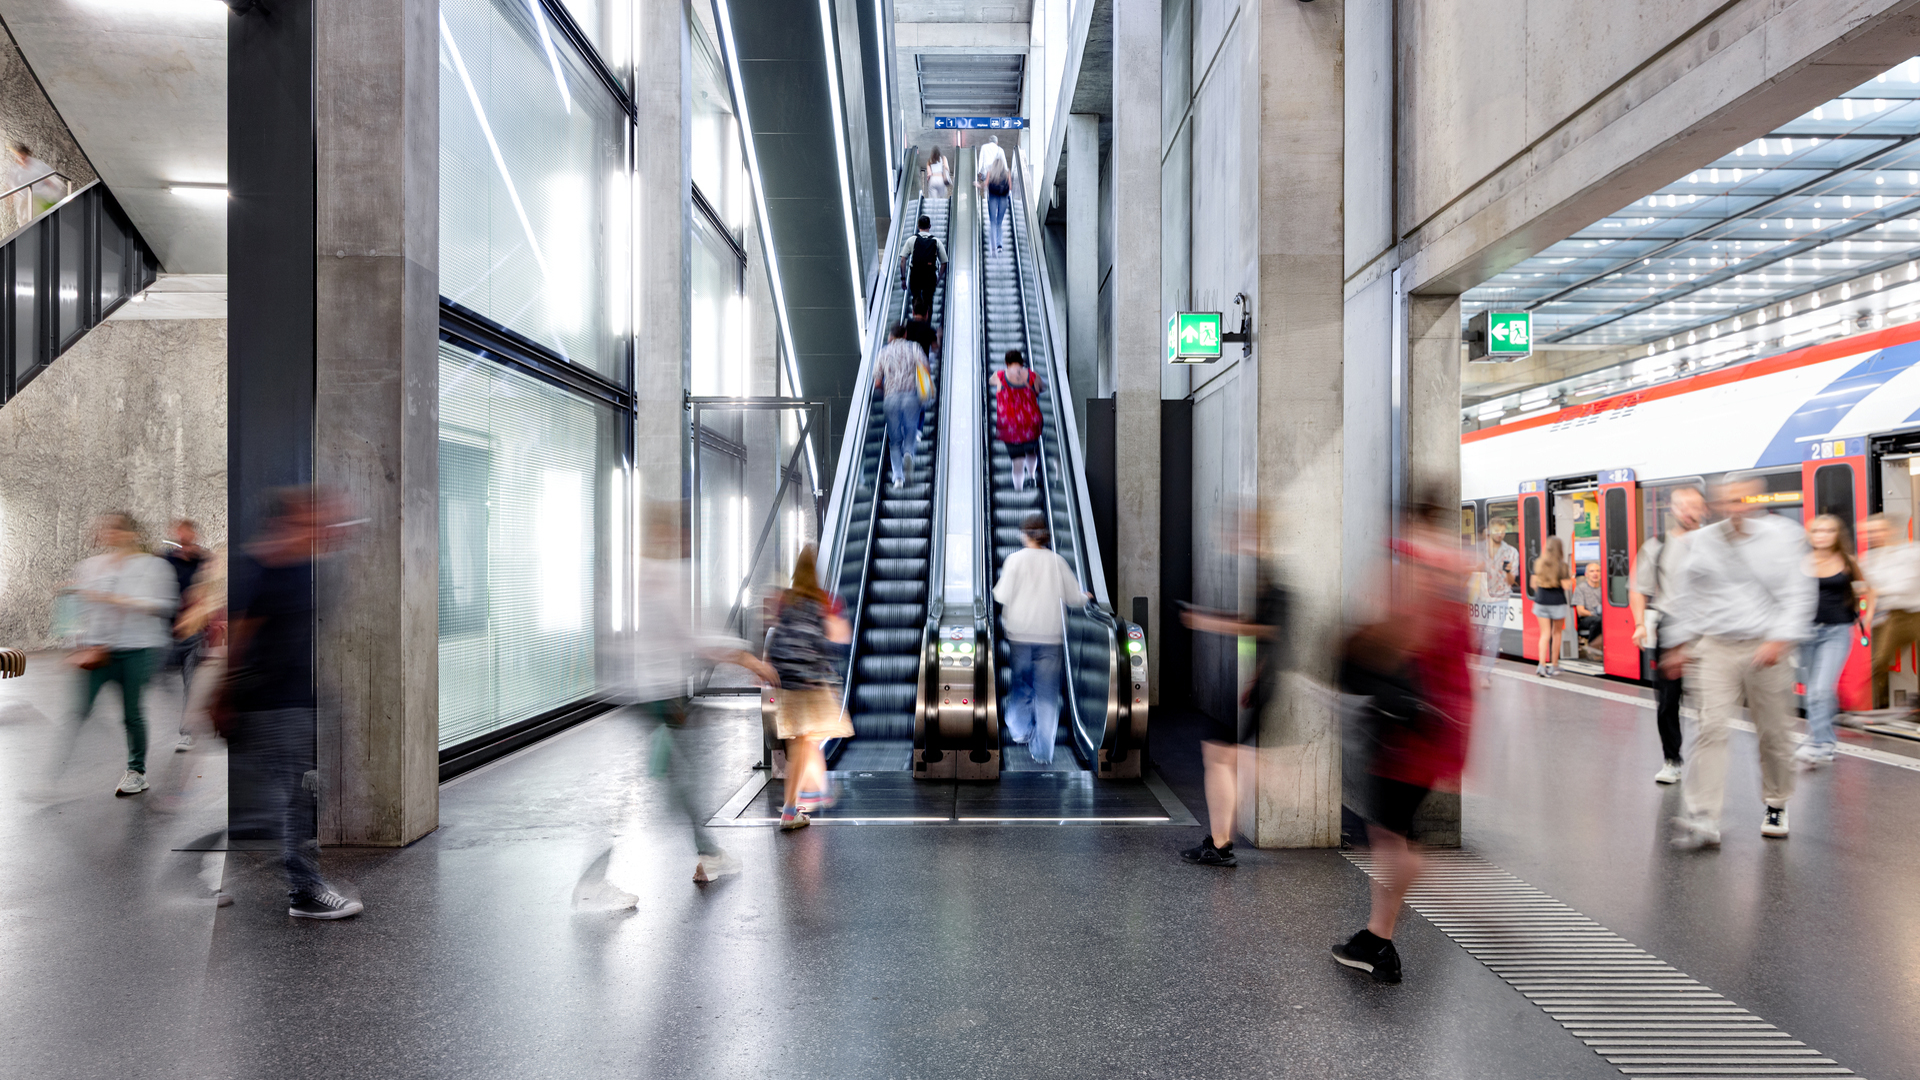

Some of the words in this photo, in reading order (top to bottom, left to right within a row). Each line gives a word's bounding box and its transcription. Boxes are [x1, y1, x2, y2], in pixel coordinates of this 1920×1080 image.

[1811, 443, 1820, 460] 2
[1623, 469, 1629, 481] 2
[1521, 482, 1527, 493] 2
[1468, 603, 1480, 618] BB
[1499, 605, 1515, 621] FFS
